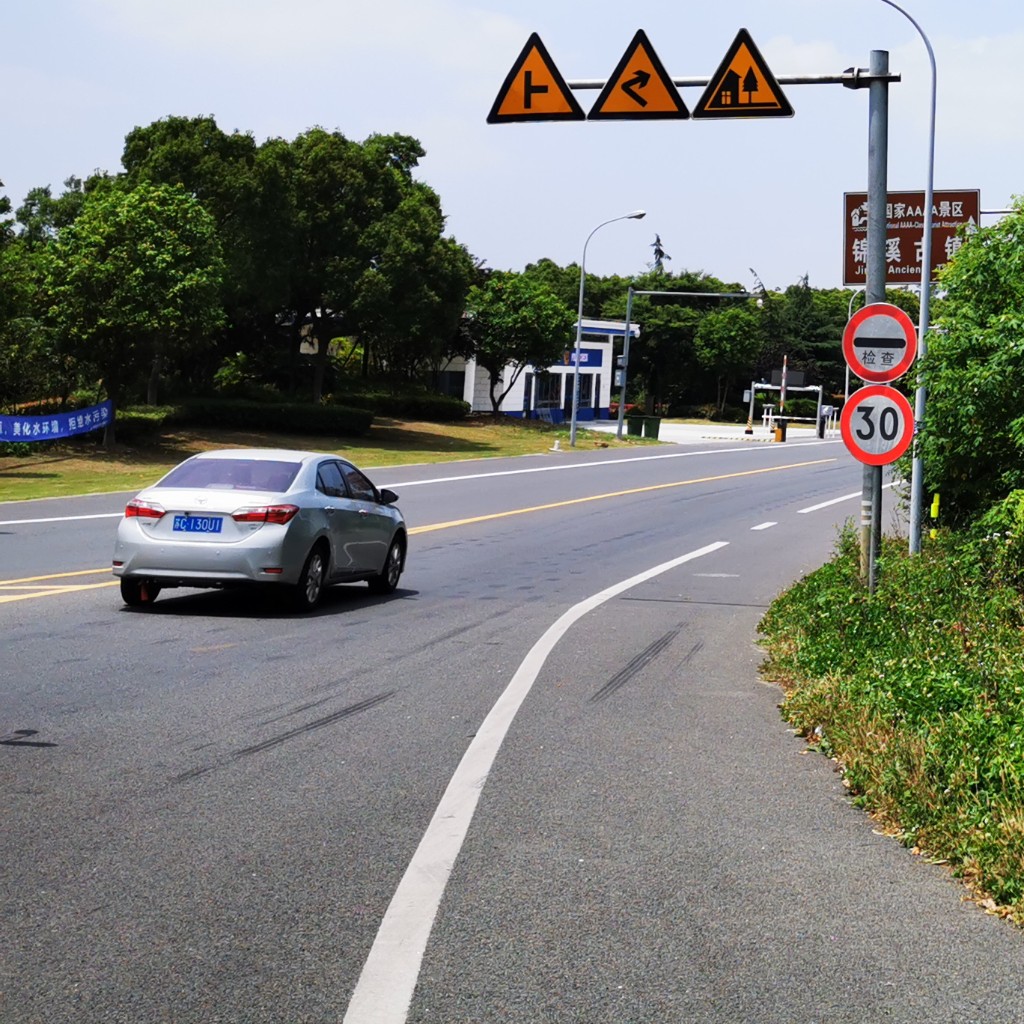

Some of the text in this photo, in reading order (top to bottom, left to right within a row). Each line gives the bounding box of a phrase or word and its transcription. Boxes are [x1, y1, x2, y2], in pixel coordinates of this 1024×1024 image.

[888, 265, 922, 274] Ancien
[861, 350, 895, 366] 检查
[856, 406, 899, 441] 30
